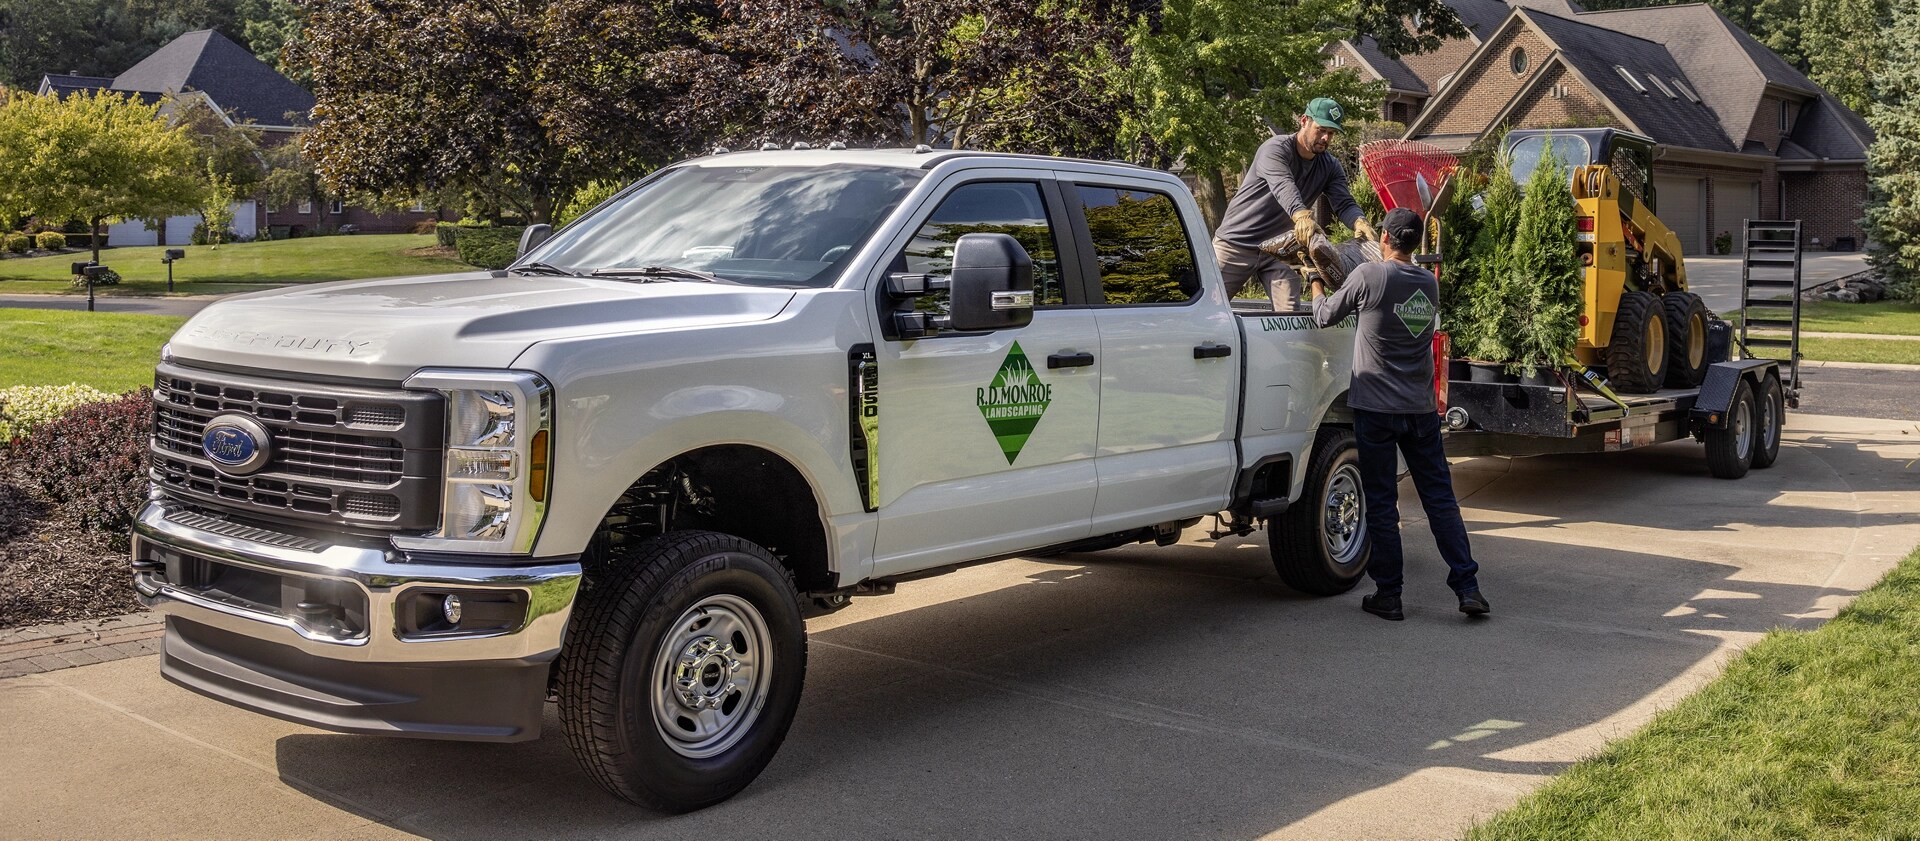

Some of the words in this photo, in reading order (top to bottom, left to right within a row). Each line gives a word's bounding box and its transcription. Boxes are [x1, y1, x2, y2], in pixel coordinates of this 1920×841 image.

[1260, 316, 1319, 332] LANDSCAPIN
[273, 334, 374, 355] DUTY
[986, 404, 1043, 419] LANDSCAPING
[212, 430, 244, 458] Ford
